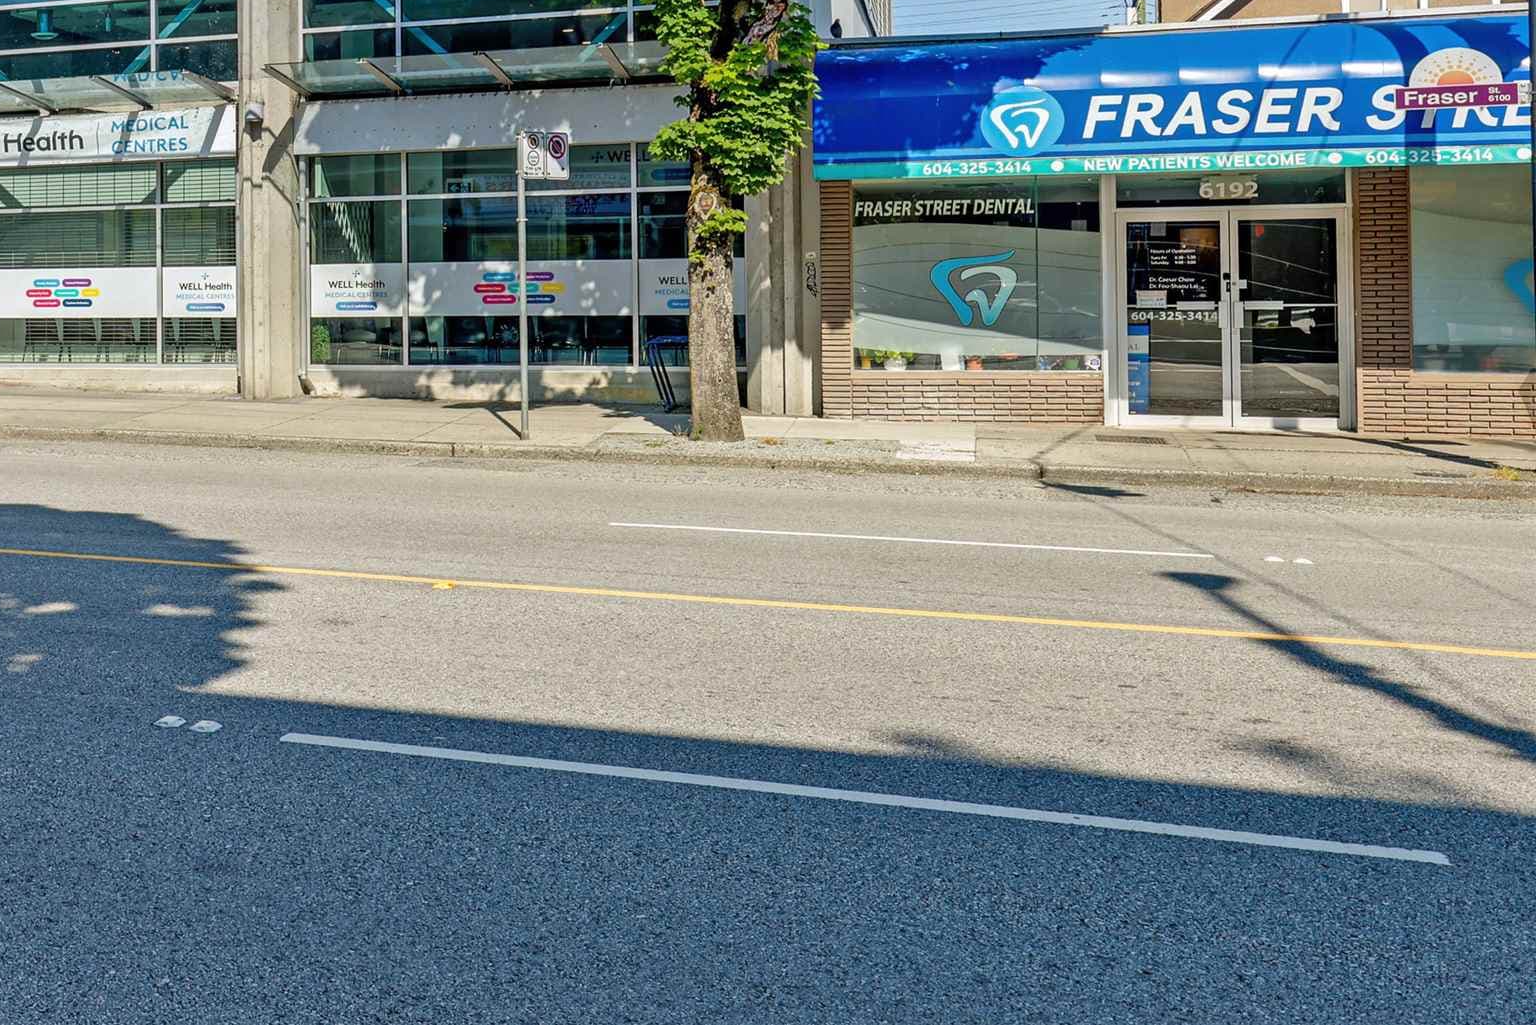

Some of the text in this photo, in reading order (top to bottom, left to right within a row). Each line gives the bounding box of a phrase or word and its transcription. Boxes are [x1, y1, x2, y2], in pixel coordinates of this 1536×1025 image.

[1404, 86, 1501, 105] Fraser St.
[1488, 94, 1511, 102] 6100
[1082, 86, 1343, 139] FRASER
[111, 115, 189, 133] MEDICAL
[3, 129, 84, 153] Health
[111, 136, 188, 155] CENTRES
[922, 147, 1494, 175] 604-325-3414 NEW PATIENTS WELCOME 604-325-3414
[1199, 182, 1259, 199] 6192
[854, 198, 1035, 217] FRASER STREET DENTAL
[179, 281, 233, 291] WELL Health
[328, 279, 386, 289] WELL Health
[658, 277, 688, 285] WELL
[1131, 311, 1218, 321] 604-325-3414
